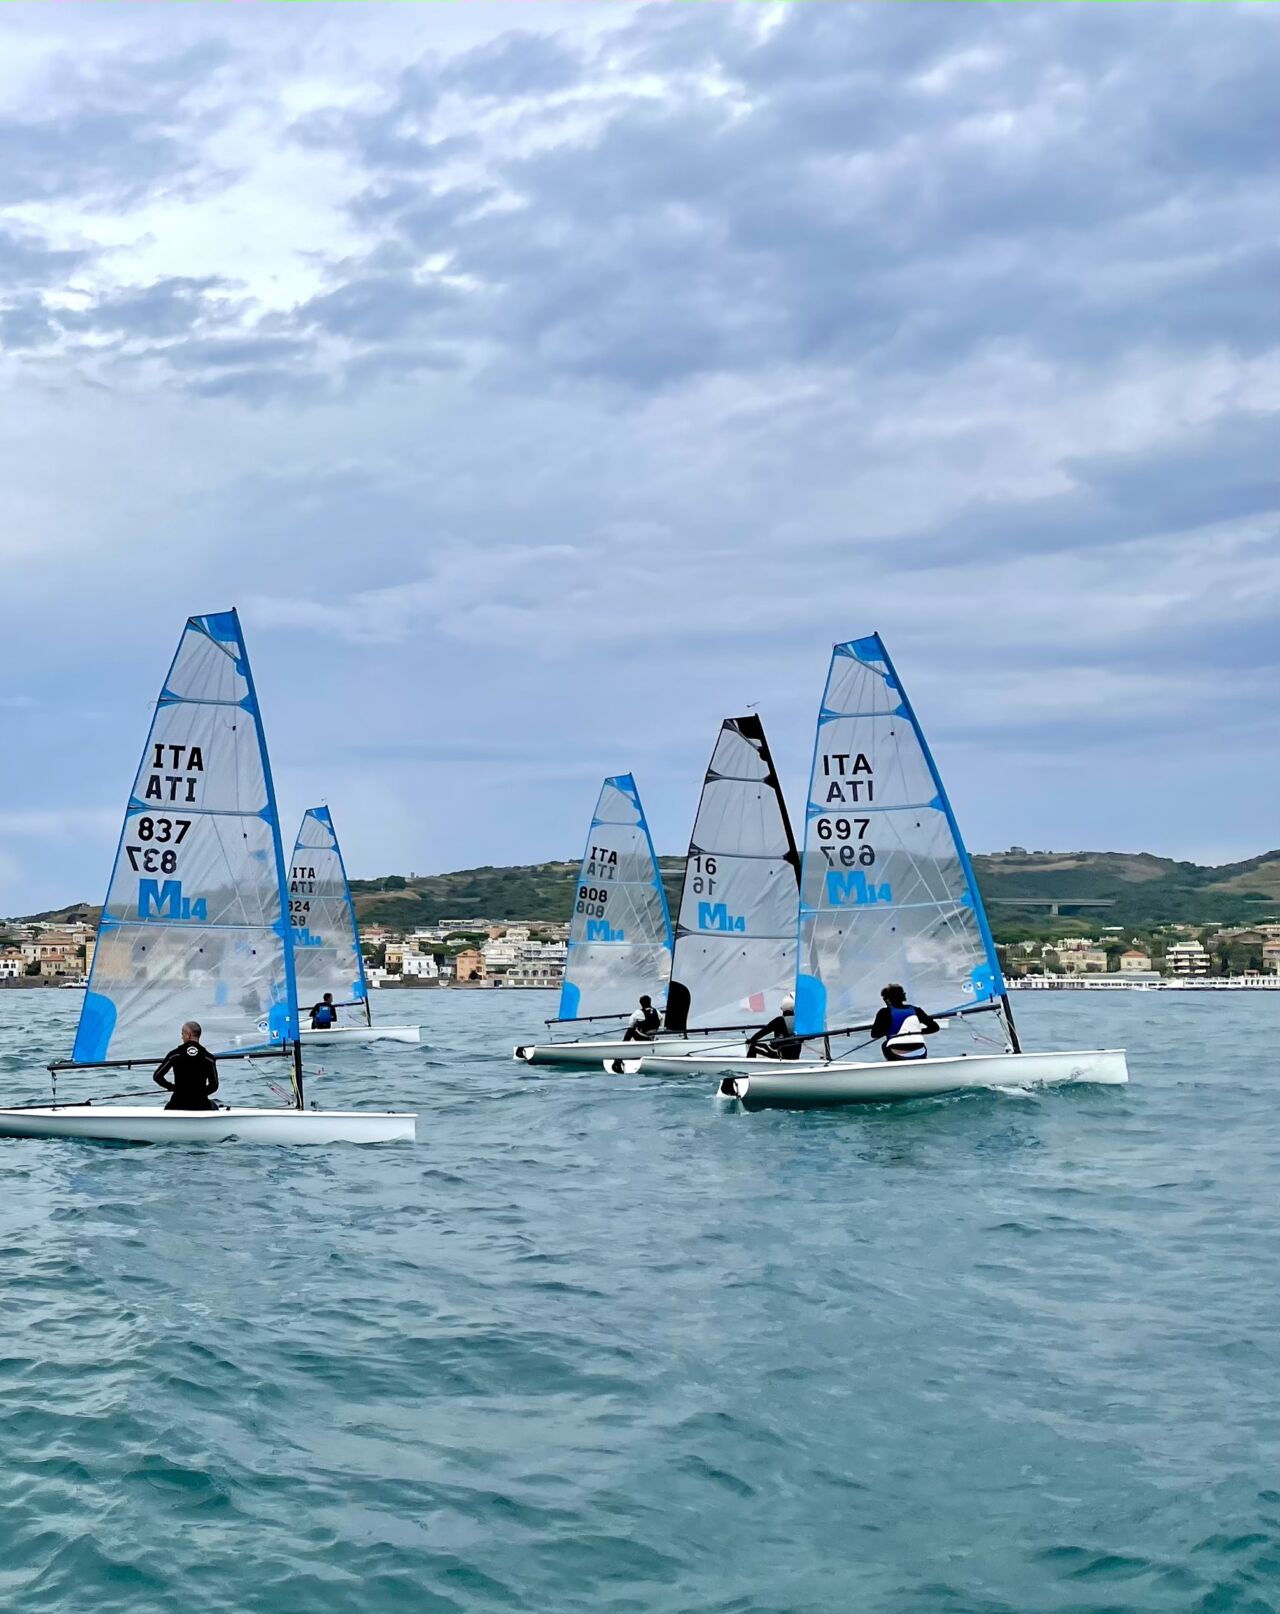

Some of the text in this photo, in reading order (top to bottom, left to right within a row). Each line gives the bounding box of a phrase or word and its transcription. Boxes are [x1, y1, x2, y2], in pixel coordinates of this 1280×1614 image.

[153, 743, 204, 771] ITA
[823, 753, 873, 776] ITA
[138, 817, 192, 844] 837
[817, 818, 870, 840] 697
[590, 846, 618, 865] ITA
[693, 856, 717, 875] 16
[293, 867, 315, 878] ITA
[138, 878, 208, 921] M14
[579, 886, 607, 903] 808
